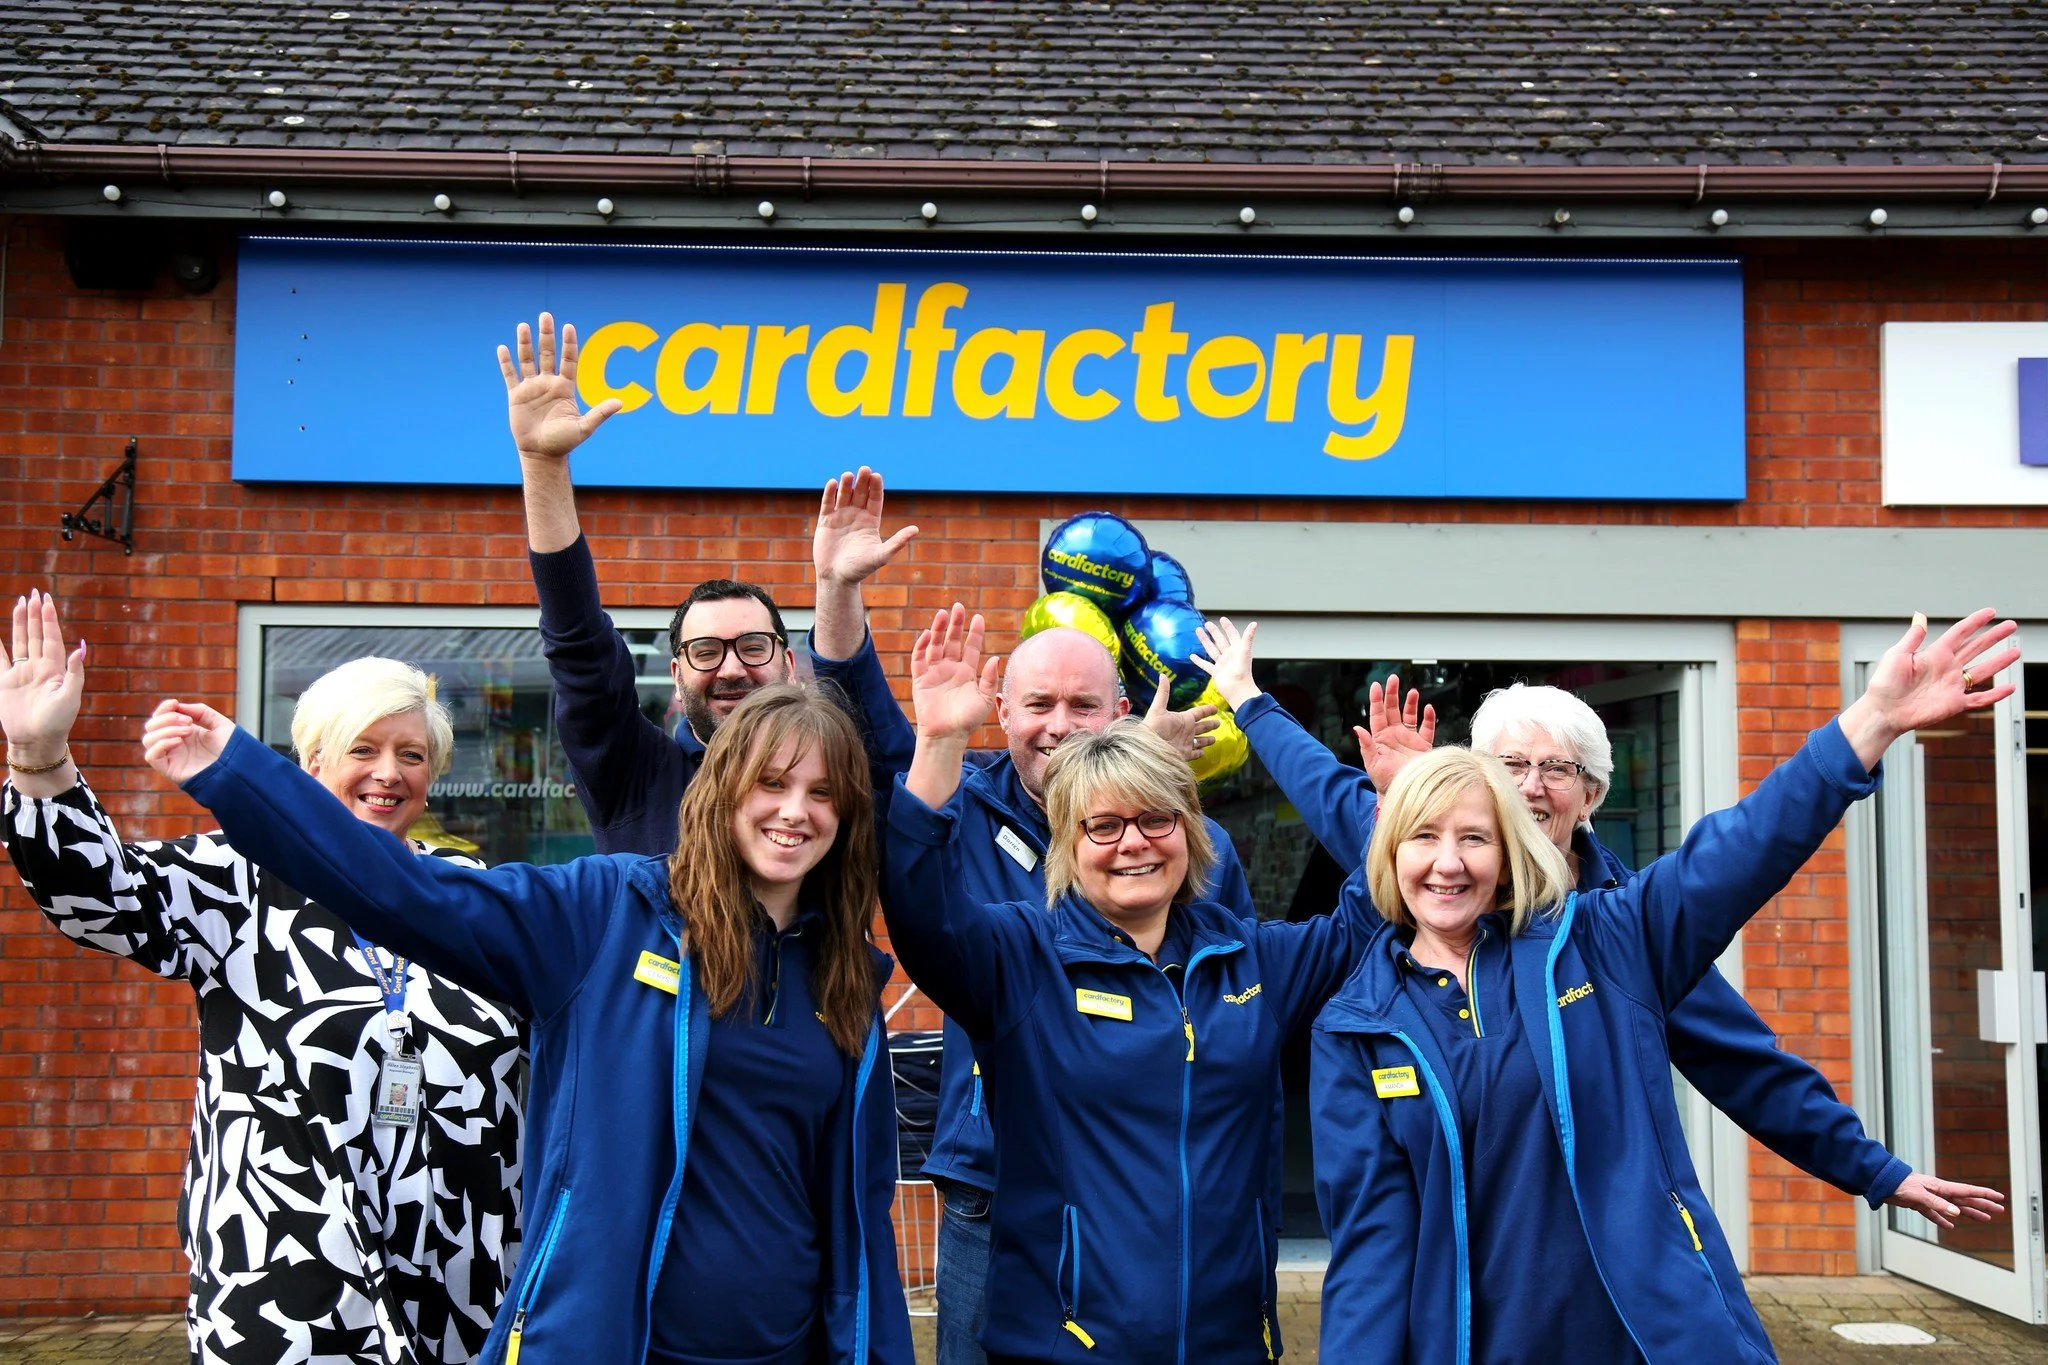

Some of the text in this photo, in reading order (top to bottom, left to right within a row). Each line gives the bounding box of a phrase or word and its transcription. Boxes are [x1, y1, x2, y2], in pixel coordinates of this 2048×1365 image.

[575, 281, 1415, 461] cardfactory
[1048, 548, 1135, 588] cardfactory
[364, 946, 390, 995] Card Factory
[393, 975, 403, 994] Card
[1083, 993, 1125, 1006] cardfactory
[1378, 1069, 1410, 1080] cardfactory
